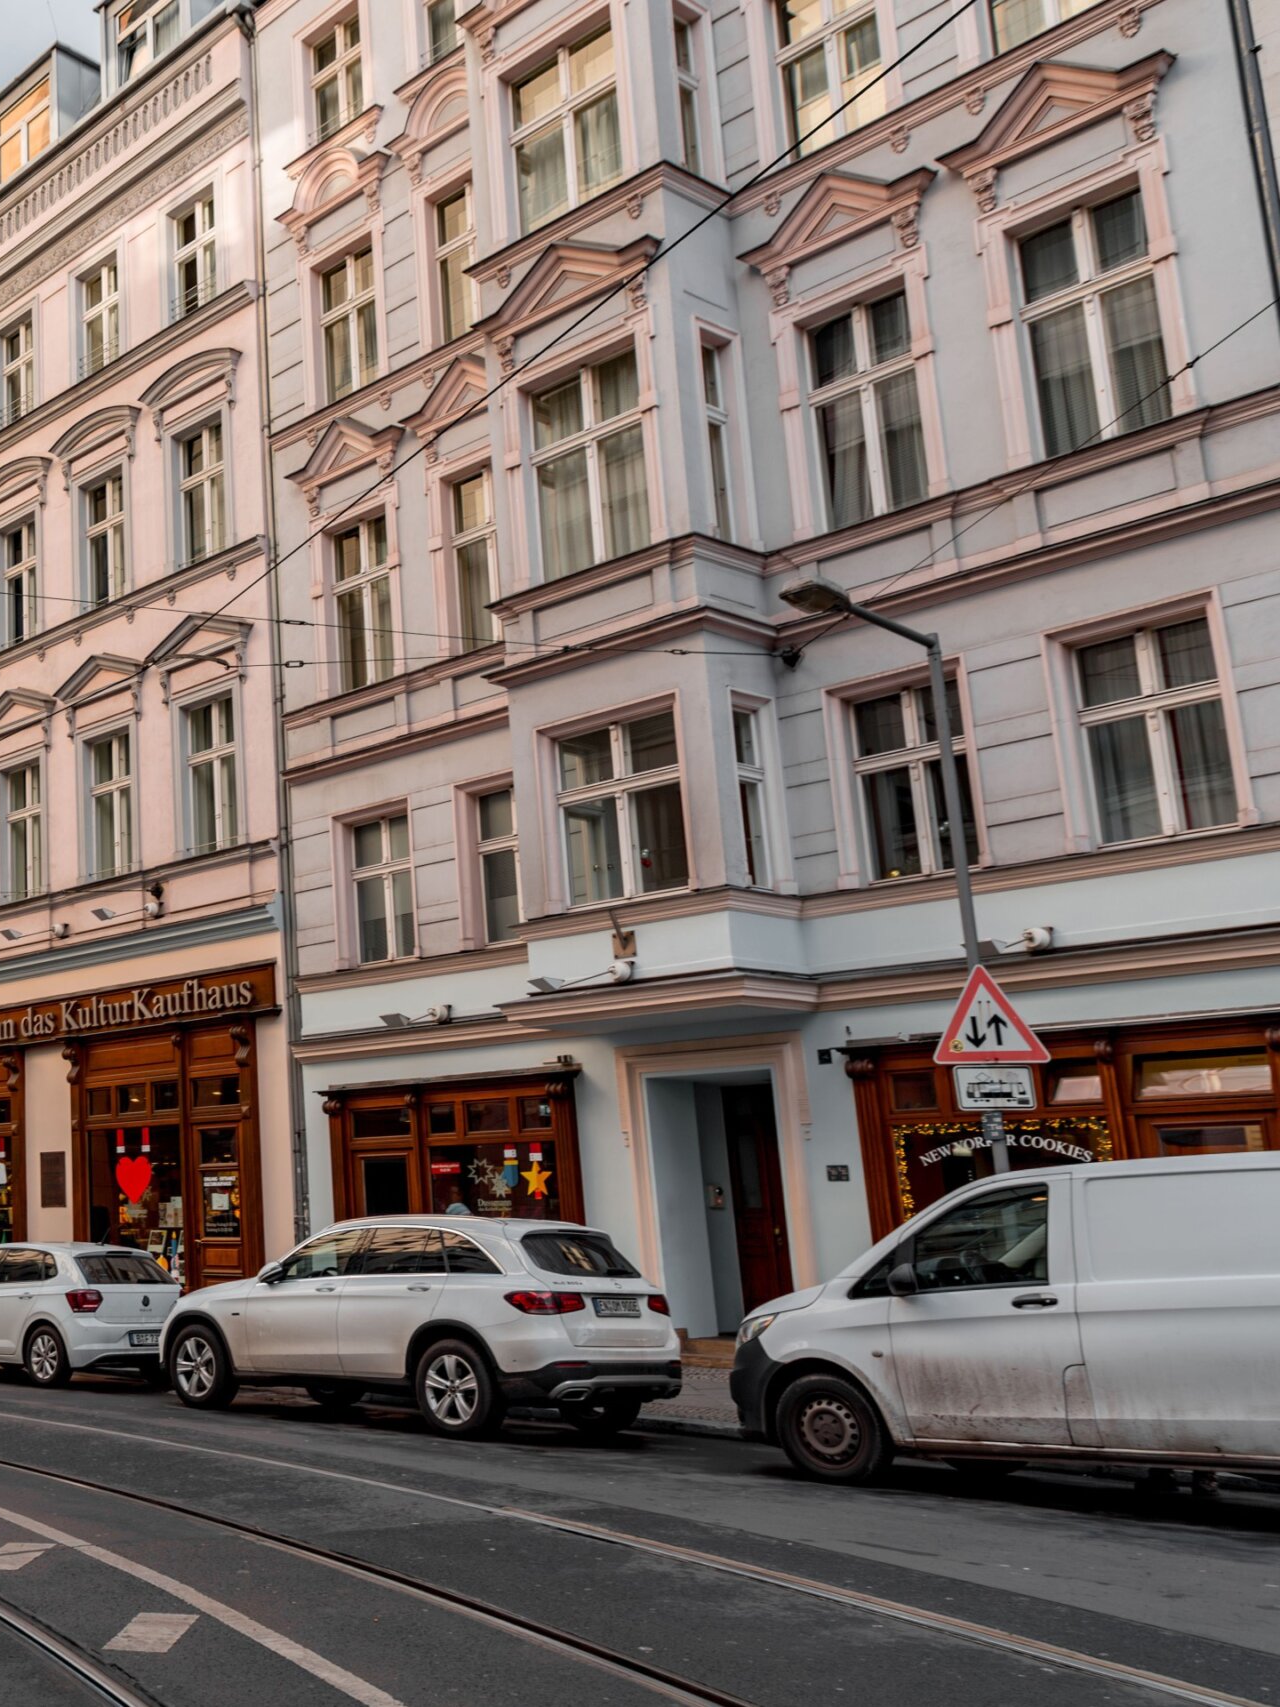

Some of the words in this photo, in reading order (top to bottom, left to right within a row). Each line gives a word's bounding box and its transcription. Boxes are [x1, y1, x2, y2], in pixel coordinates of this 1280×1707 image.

[20, 1007, 55, 1037] das
[59, 979, 253, 1031] KulturKaufhaus
[919, 1144, 952, 1166] NEW
[952, 1134, 1018, 1152] YORR
[1020, 1135, 1094, 1163] COOKIES
